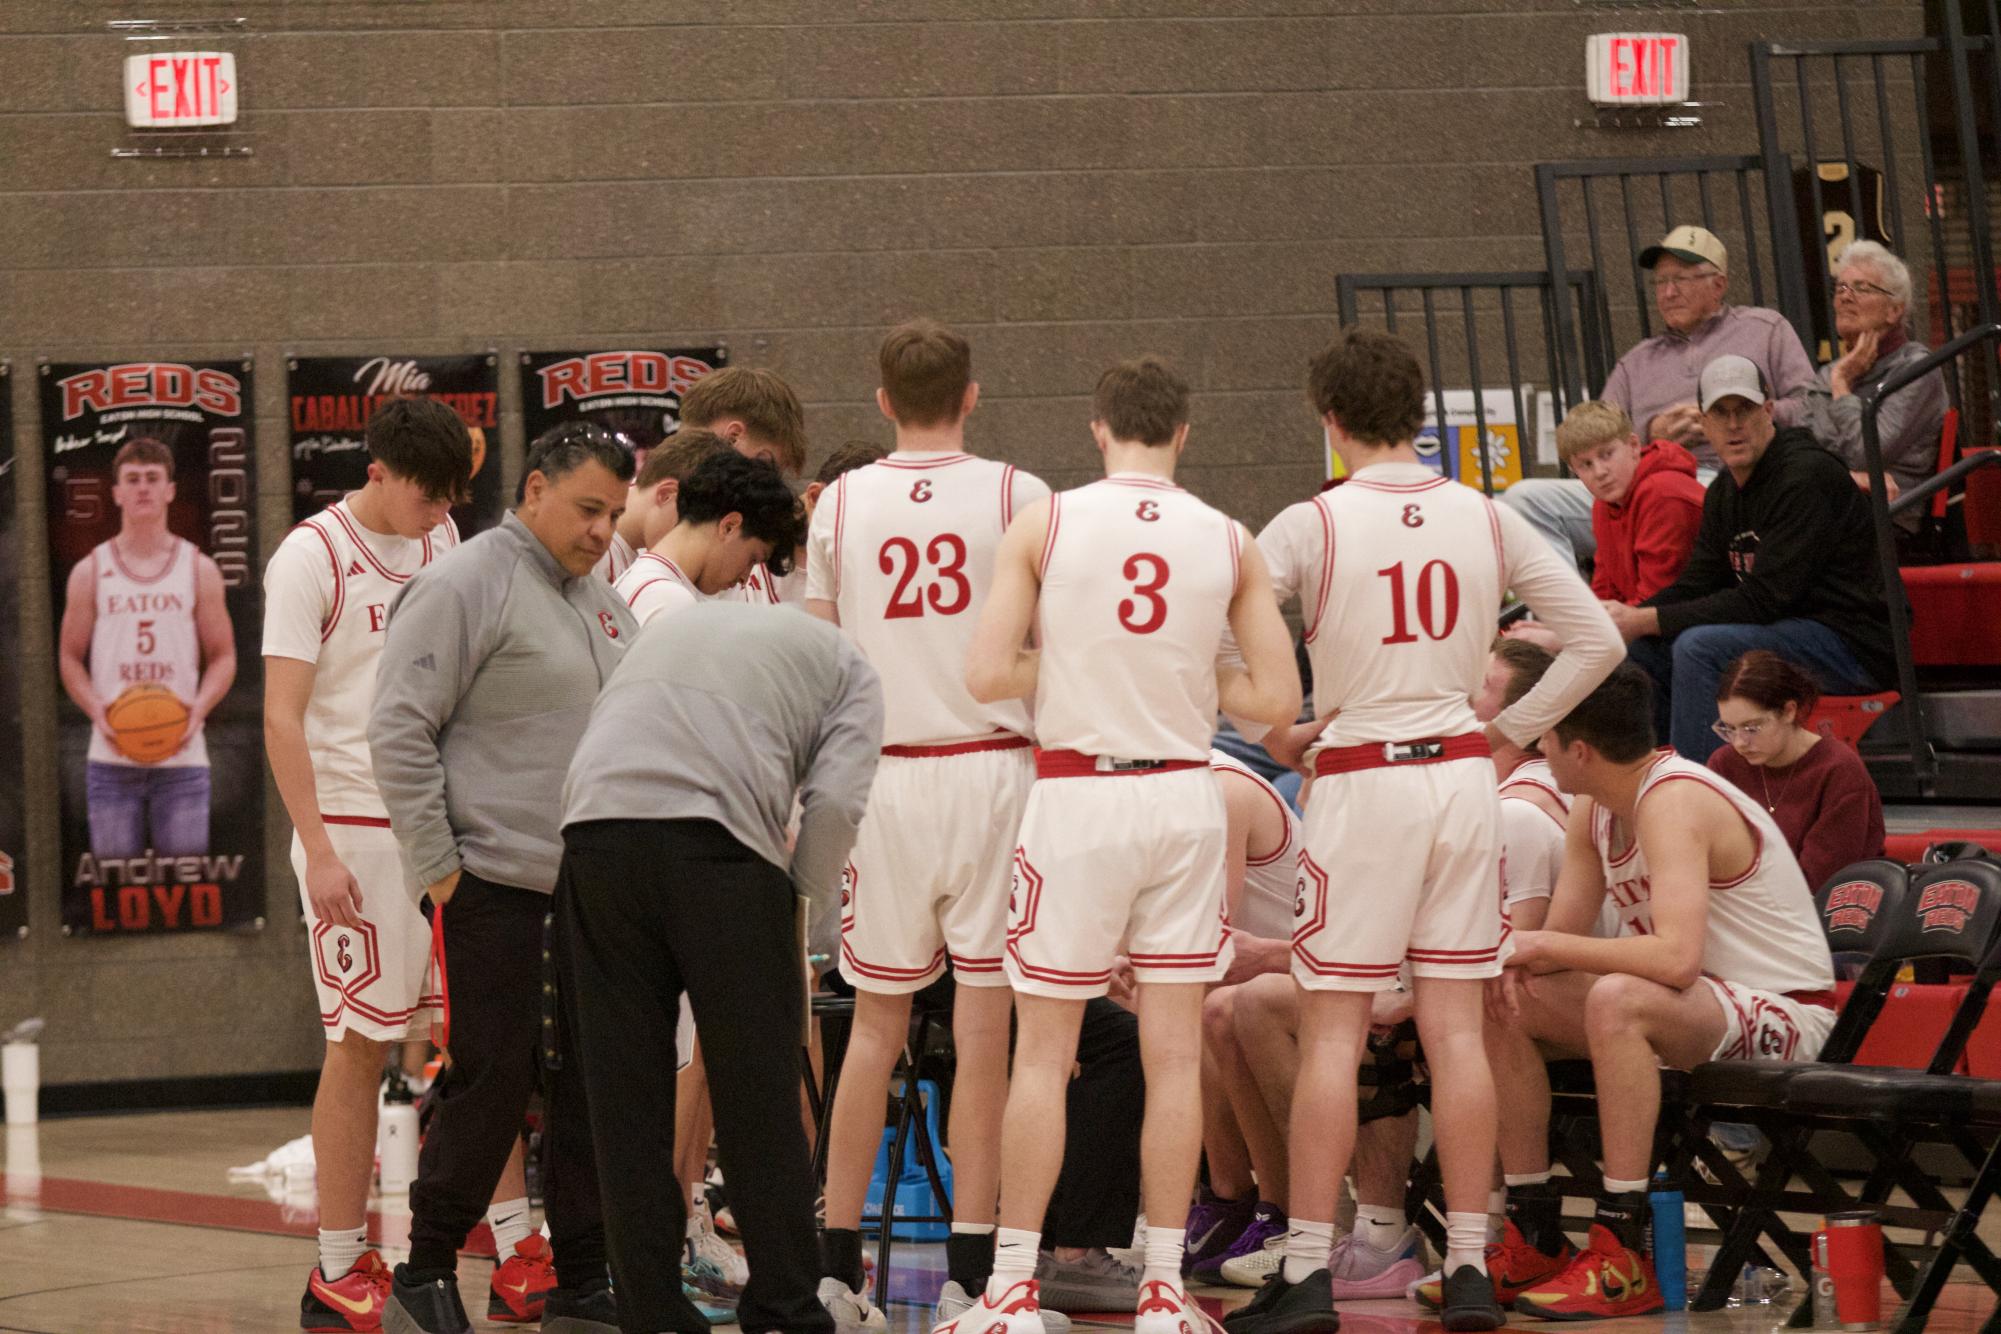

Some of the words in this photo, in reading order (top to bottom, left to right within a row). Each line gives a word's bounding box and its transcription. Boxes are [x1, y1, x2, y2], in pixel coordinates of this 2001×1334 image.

[1609, 38, 1678, 97] EXIT
[149, 58, 221, 119] EXIT
[56, 363, 242, 421] REDS
[353, 357, 432, 396] Mia
[879, 533, 972, 619] 23
[1118, 552, 1170, 635] 3
[107, 593, 183, 615] EATON
[1378, 559, 1459, 645] 10
[137, 620, 155, 655] 5
[119, 662, 174, 681] REDS
[74, 849, 244, 886] Andrew
[90, 883, 222, 930] LOYD
[1825, 880, 1885, 919] EATON
[1917, 880, 1981, 919] EATON
[1817, 1277, 1835, 1297] G
